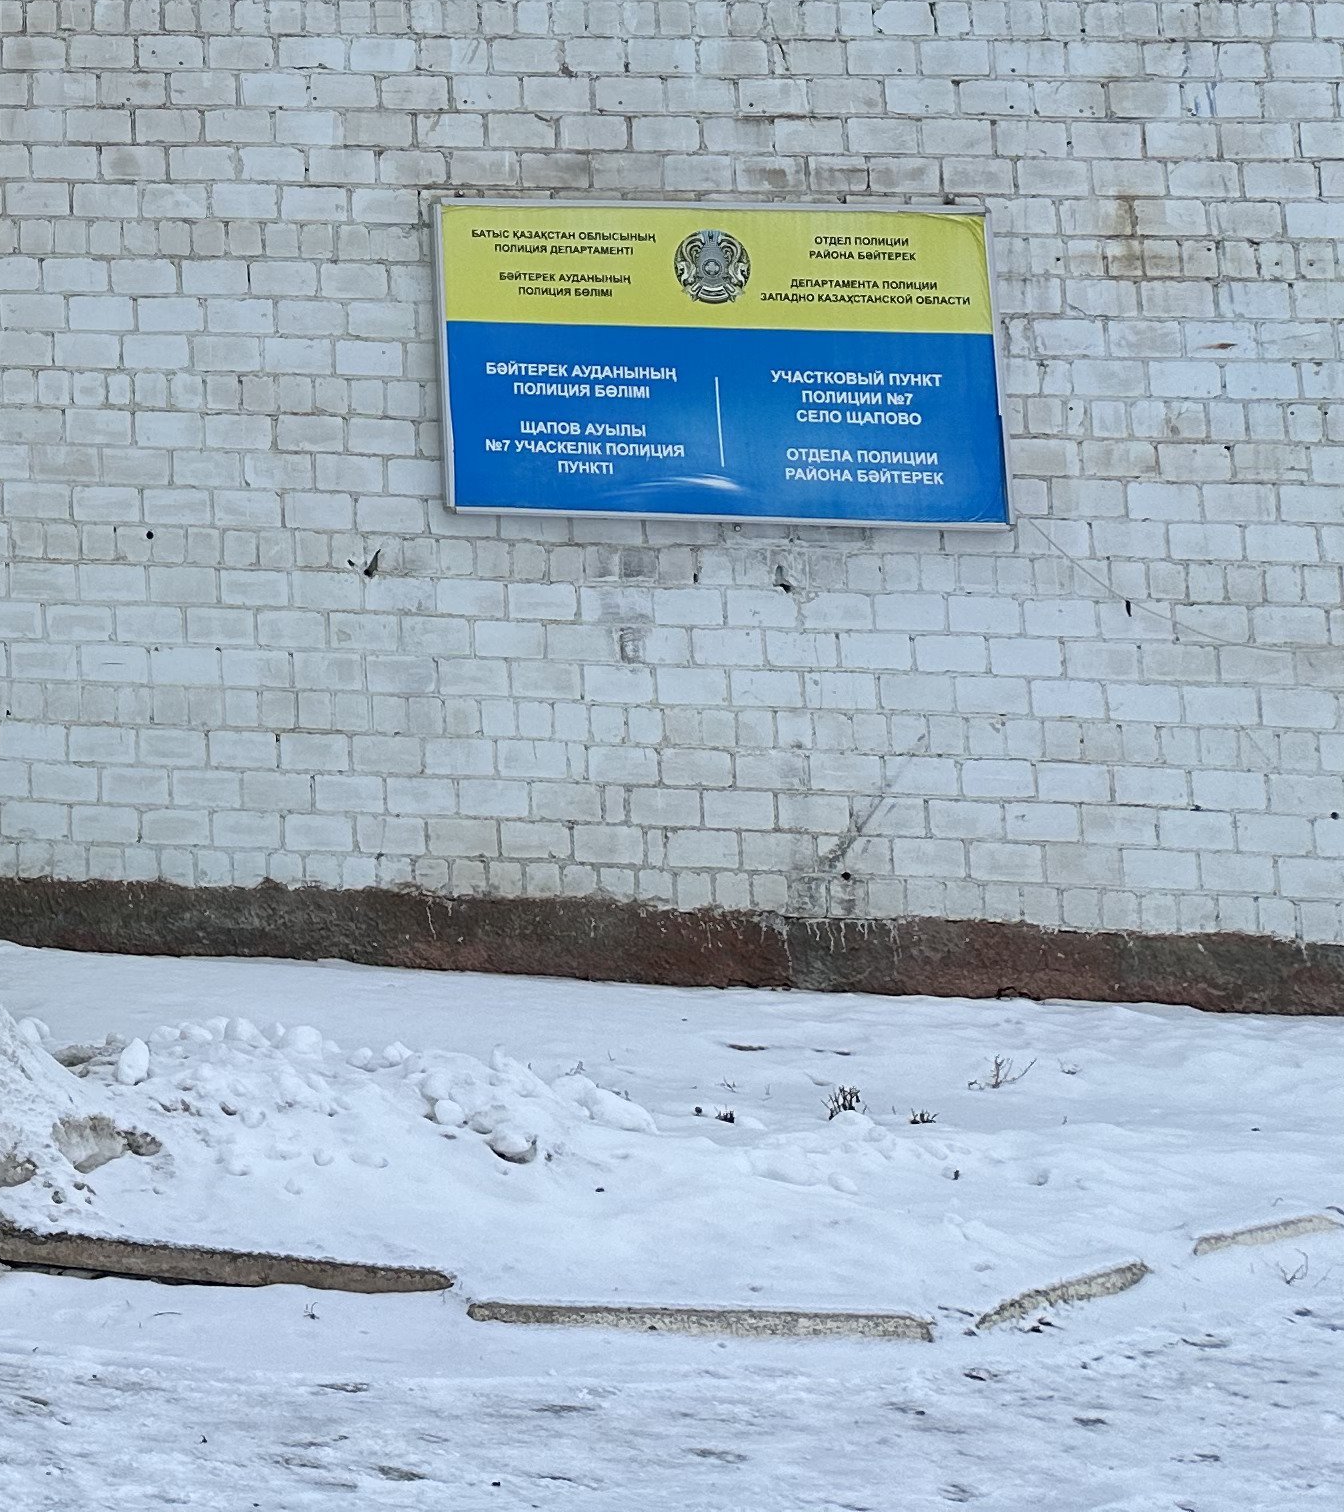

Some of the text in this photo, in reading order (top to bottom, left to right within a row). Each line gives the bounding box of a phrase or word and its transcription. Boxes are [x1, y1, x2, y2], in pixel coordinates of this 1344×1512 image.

[472, 229, 656, 243] БАТЫС ҚАЗАҚСТАН ОБЛЫСЫНЫҢ
[815, 236, 909, 247] ОТДЕЛ ПОЛИЦИИ
[495, 244, 633, 256] ПОЛИЦИЯ ДЕПАРТАМЕНТІ
[809, 249, 916, 261] РАЙОНА БӘЙТЕРЕК
[499, 271, 631, 284] БӘЙТЕРЕК АУДАНЫНЫҢ
[790, 279, 937, 291] ДЕПАРТАМЕНТА ПОЛИЦИИ
[519, 287, 612, 297] ПОЛИЦИЯ БӨЛІМІ
[761, 293, 814, 303] ЗАПАДНО
[916, 295, 970, 306] ОБЛАСТИ
[486, 361, 677, 382] БӘЙТЕРЕК АУДАНЫНЫҢ
[771, 370, 942, 387] УЧАСТКОВЫЙ ПУНКТ
[514, 382, 650, 398] ПОЛИЦИЯ БӨЛІМІ
[802, 390, 913, 406] ПОЛИЦИИ №7
[796, 410, 922, 426] СЕЛО ЩАПОВО
[521, 421, 646, 437] ЩАПОВ АУЫЛЫ
[486, 439, 684, 458] №7 УЧАСКЕЛІК ПОЛИЦИЯ
[786, 448, 938, 466] ОТДЕЛА ПОЛИЦИИ
[558, 461, 613, 474] ПУНКТІ
[785, 466, 944, 485] РАЙОНА БӘЙТЕРЕК
